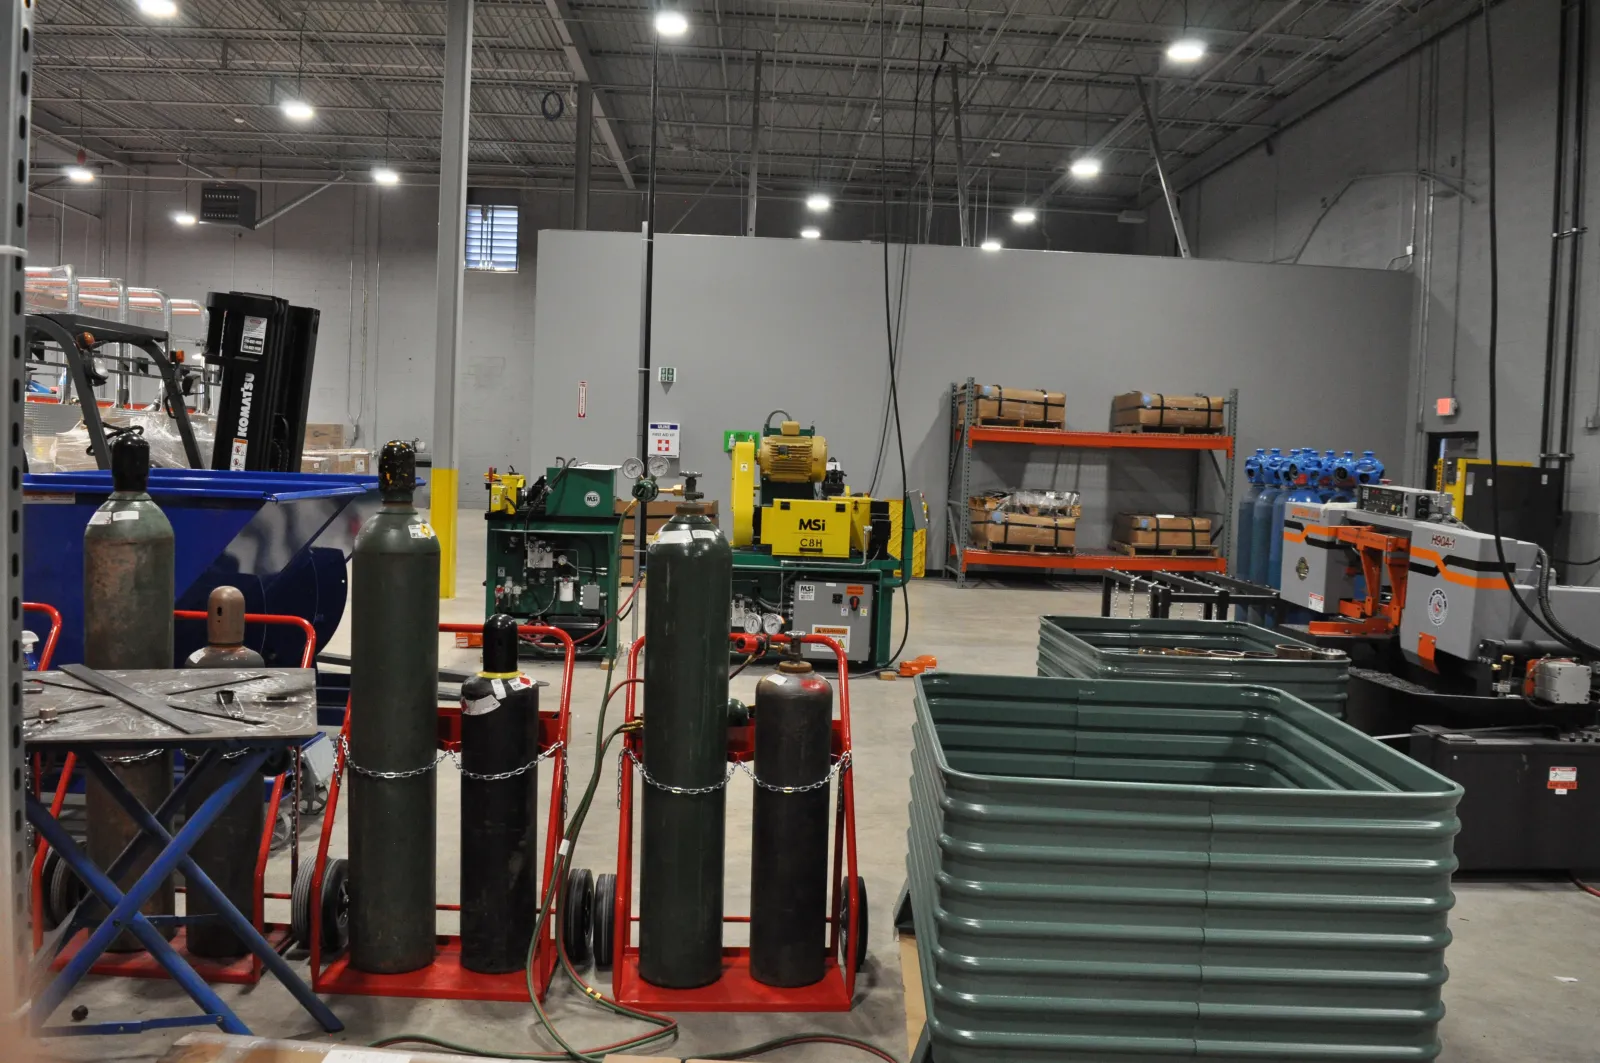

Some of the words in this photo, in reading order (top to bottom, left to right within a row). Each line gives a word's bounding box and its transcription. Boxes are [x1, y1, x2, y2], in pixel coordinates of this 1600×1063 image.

[237, 372, 255, 437] KOMATSU
[798, 518, 826, 532] MSi
[800, 538, 823, 547] C8H
[1431, 534, 1456, 549] H90A-1
